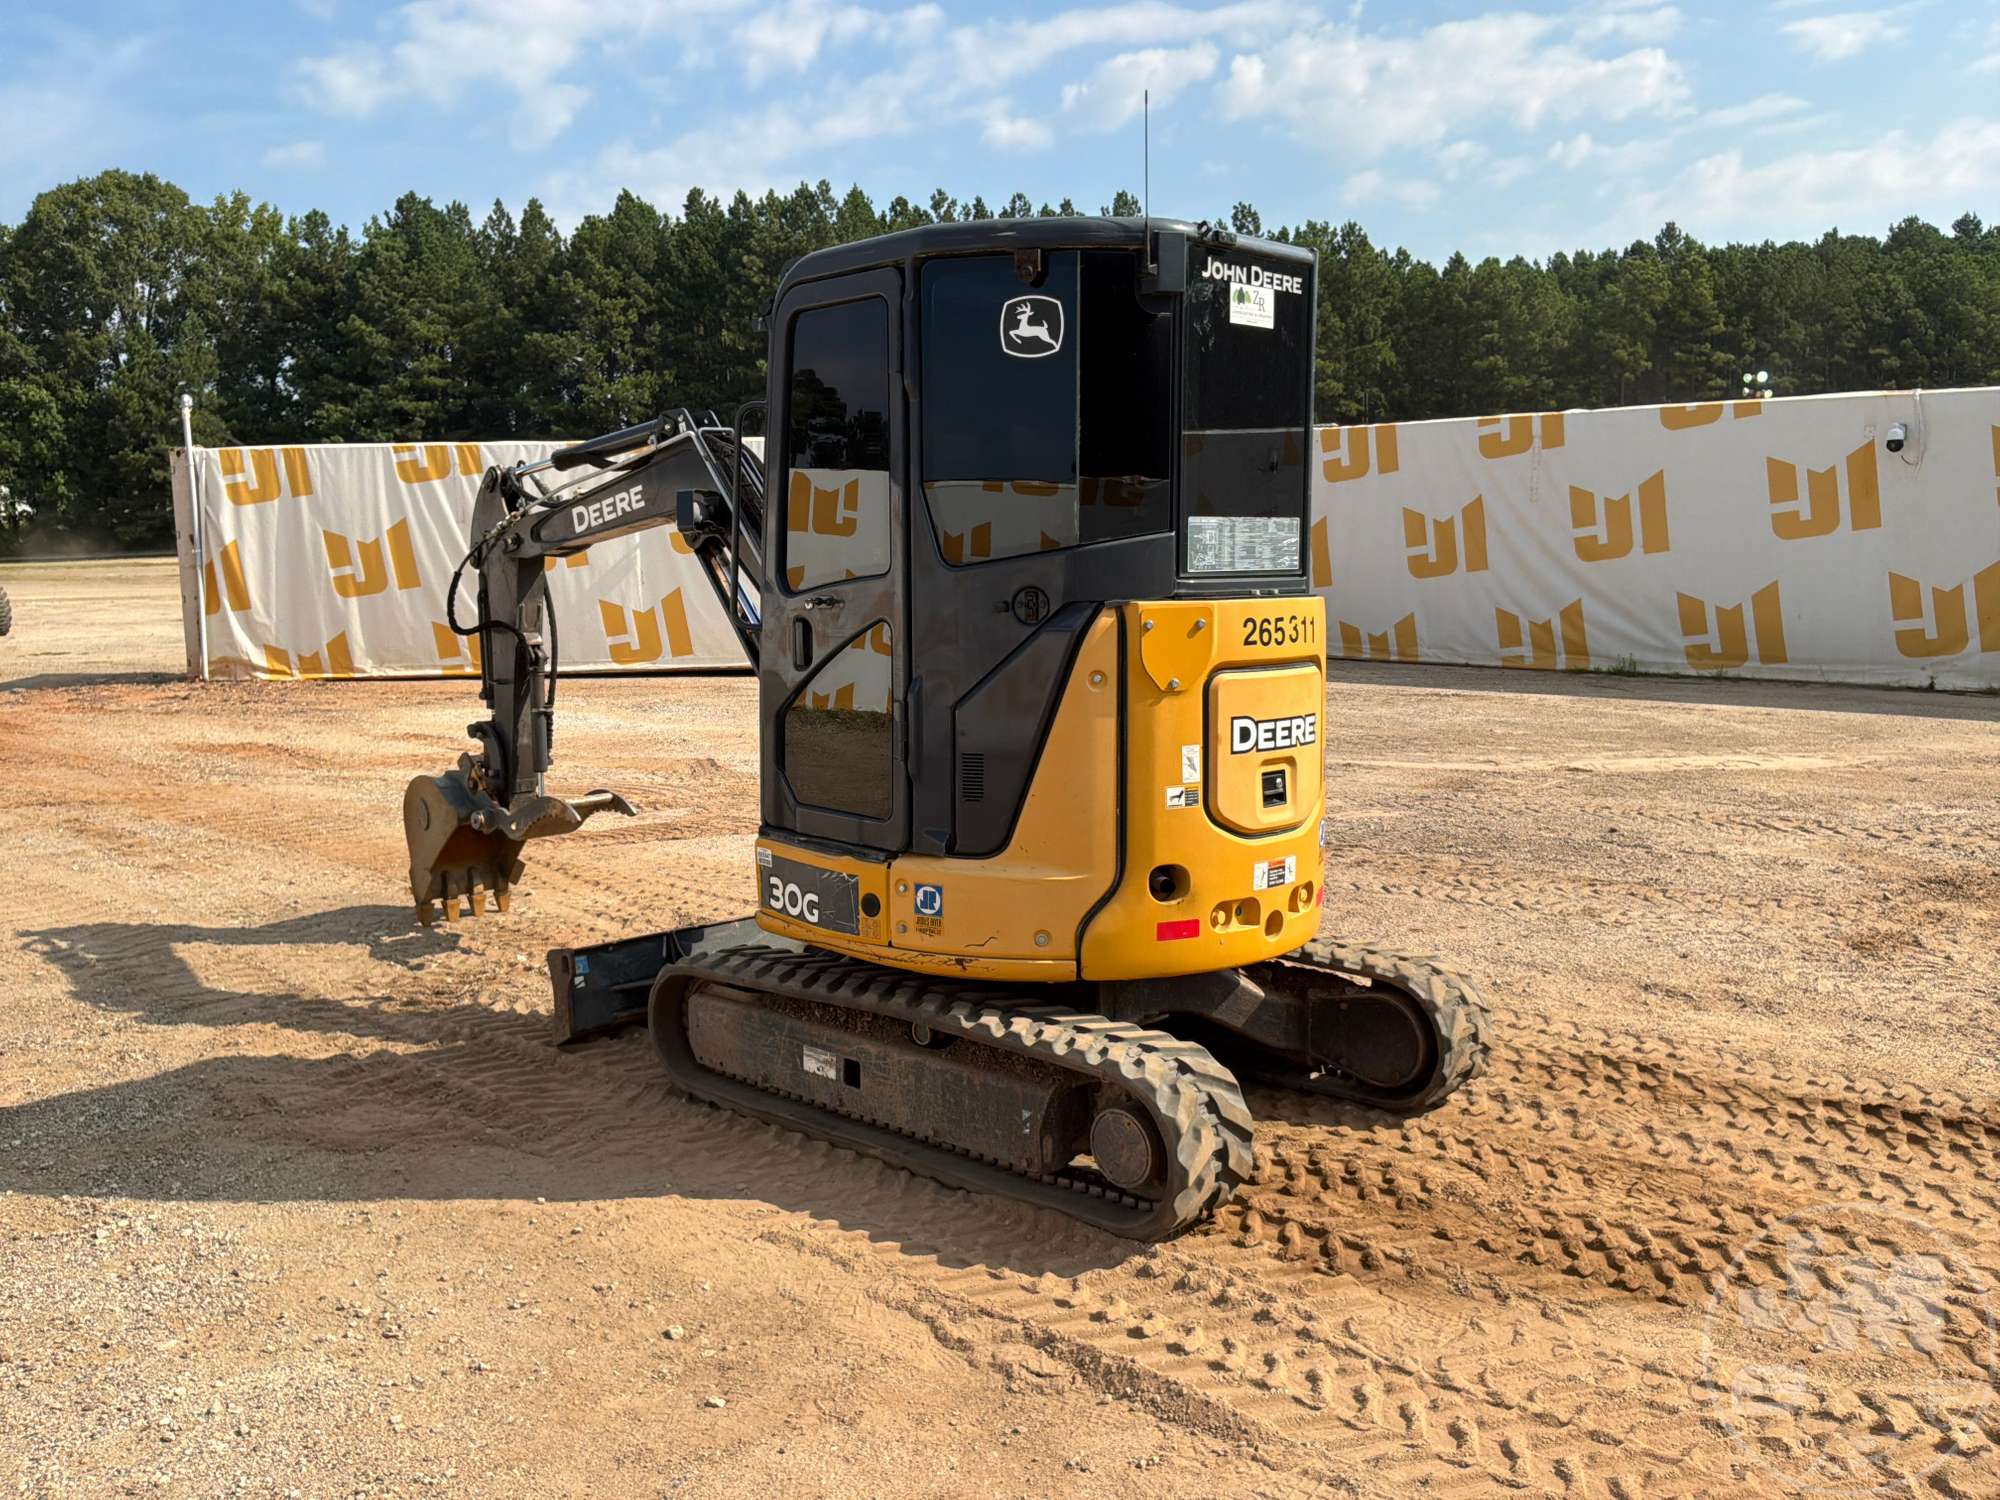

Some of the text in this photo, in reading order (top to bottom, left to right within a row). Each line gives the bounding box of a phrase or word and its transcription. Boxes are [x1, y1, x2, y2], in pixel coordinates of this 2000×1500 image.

[1202, 256, 1303, 295] JOHN DEERE
[571, 484, 646, 534] DEERE
[1242, 615, 1316, 647] 265311
[1230, 713, 1317, 755] DEERE
[768, 876, 820, 924] 30G
